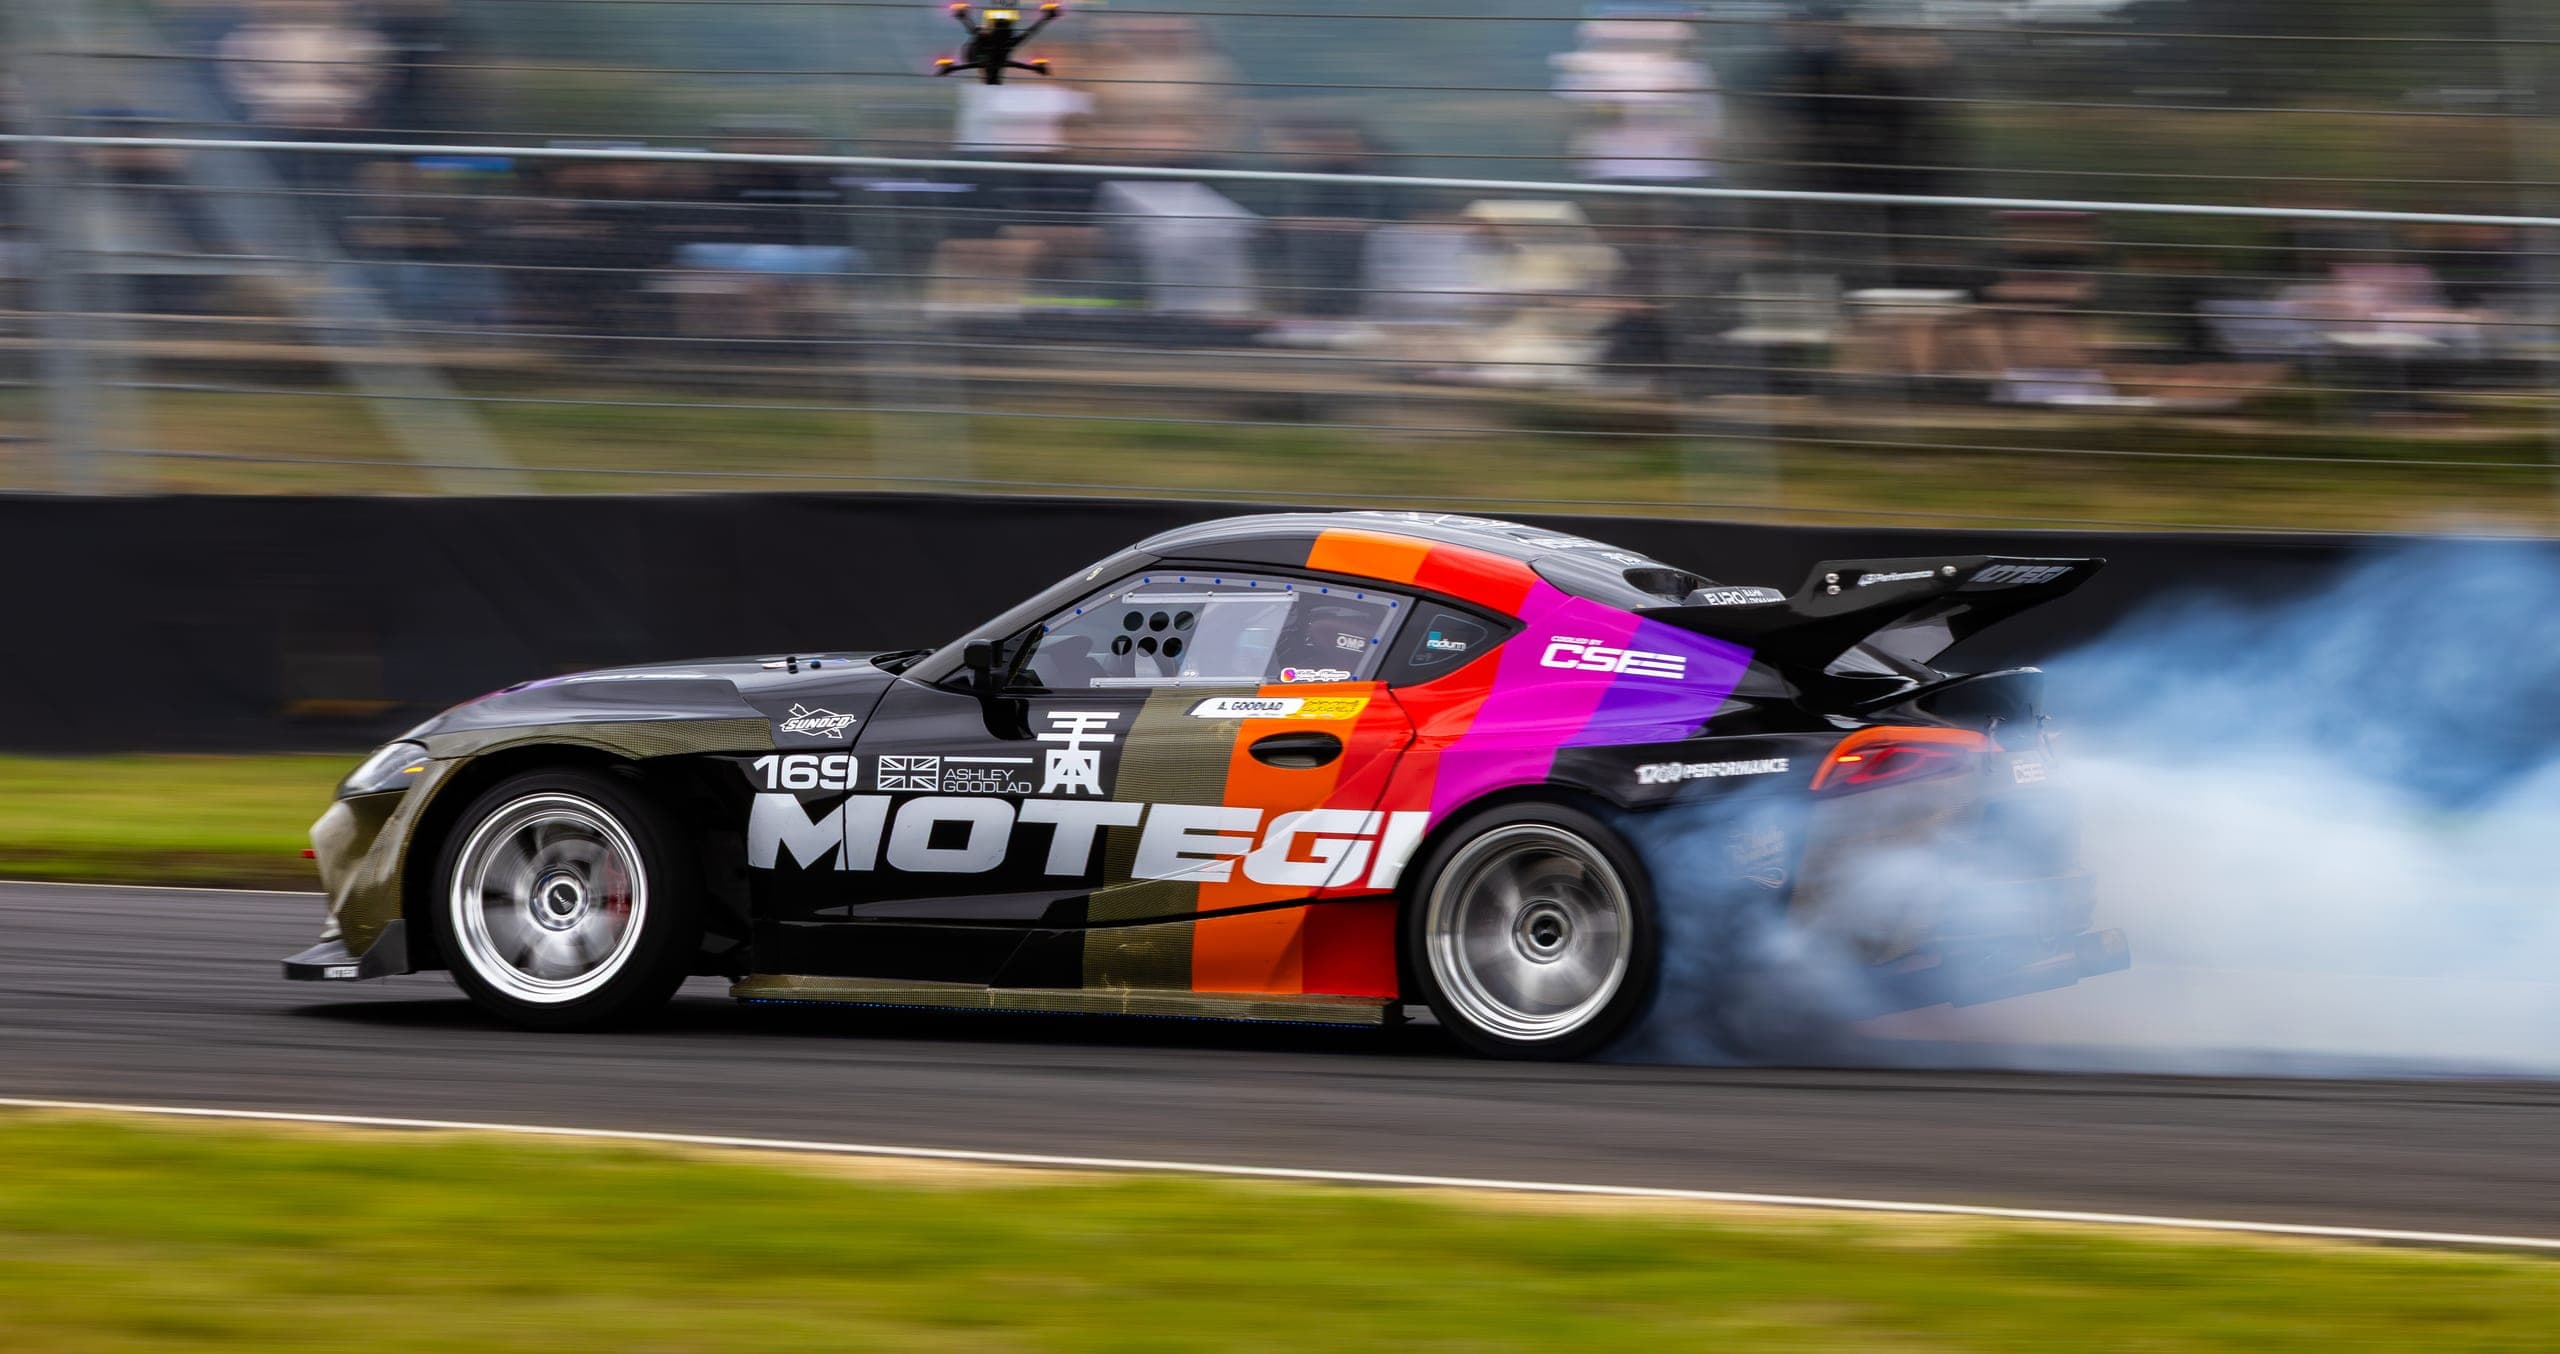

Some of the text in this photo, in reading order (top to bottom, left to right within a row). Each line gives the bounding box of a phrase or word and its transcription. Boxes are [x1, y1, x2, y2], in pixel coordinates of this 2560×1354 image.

[1704, 591, 1747, 606] EURO
[1336, 635, 1366, 650] OMP
[1231, 701, 1284, 711] GOODLAD
[785, 715, 851, 731] SUNOCO
[753, 755, 858, 790] 169
[943, 768, 1014, 781] ASHLEY
[942, 780, 1033, 794] GOODLAD
[747, 793, 1432, 889] MOTEGI
